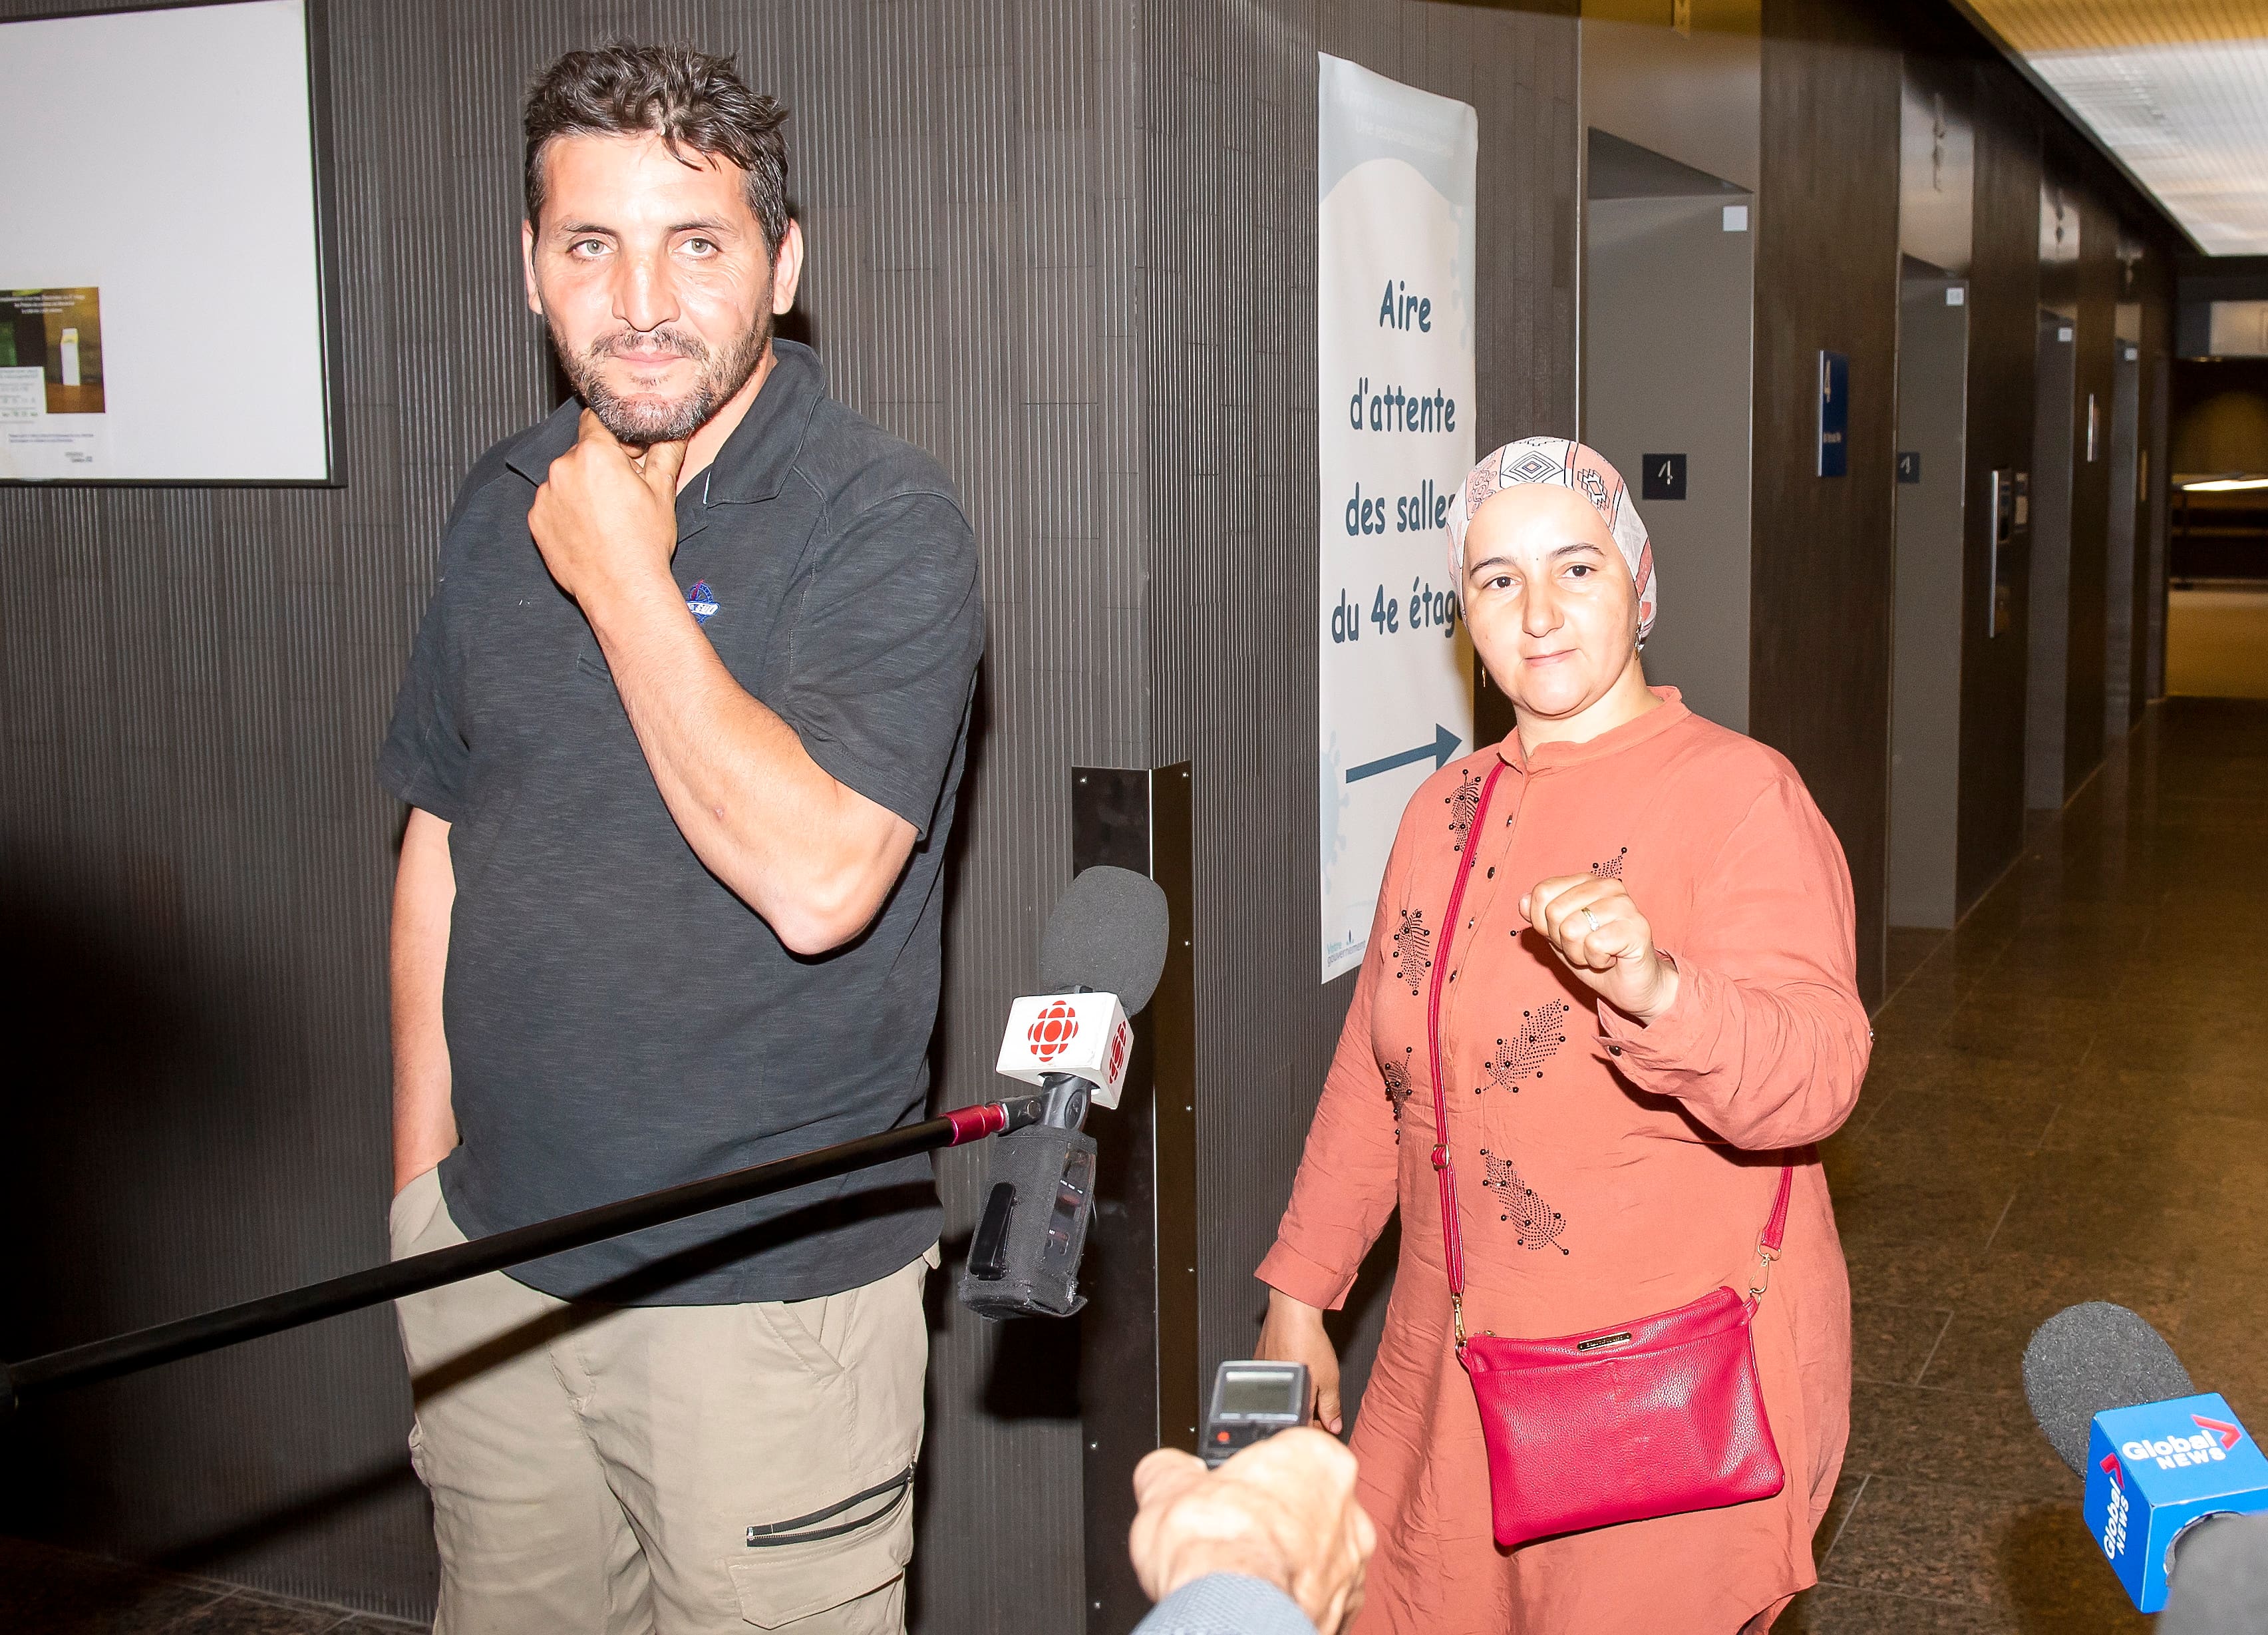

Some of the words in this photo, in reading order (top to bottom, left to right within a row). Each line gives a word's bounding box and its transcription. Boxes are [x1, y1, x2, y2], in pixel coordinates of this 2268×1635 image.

[1379, 279, 1431, 333] Aire
[1350, 377, 1455, 433] d'attente
[1824, 359, 1832, 403] 4
[1658, 460, 1673, 485] 4
[1345, 481, 1385, 536] des
[1331, 588, 1359, 643] du
[1371, 584, 1398, 635] 4e
[2122, 1429, 2217, 1461] Global
[2156, 1447, 2227, 1470] NEWS
[2103, 1476, 2121, 1560] Global
[2116, 1495, 2130, 1556] NEWS
